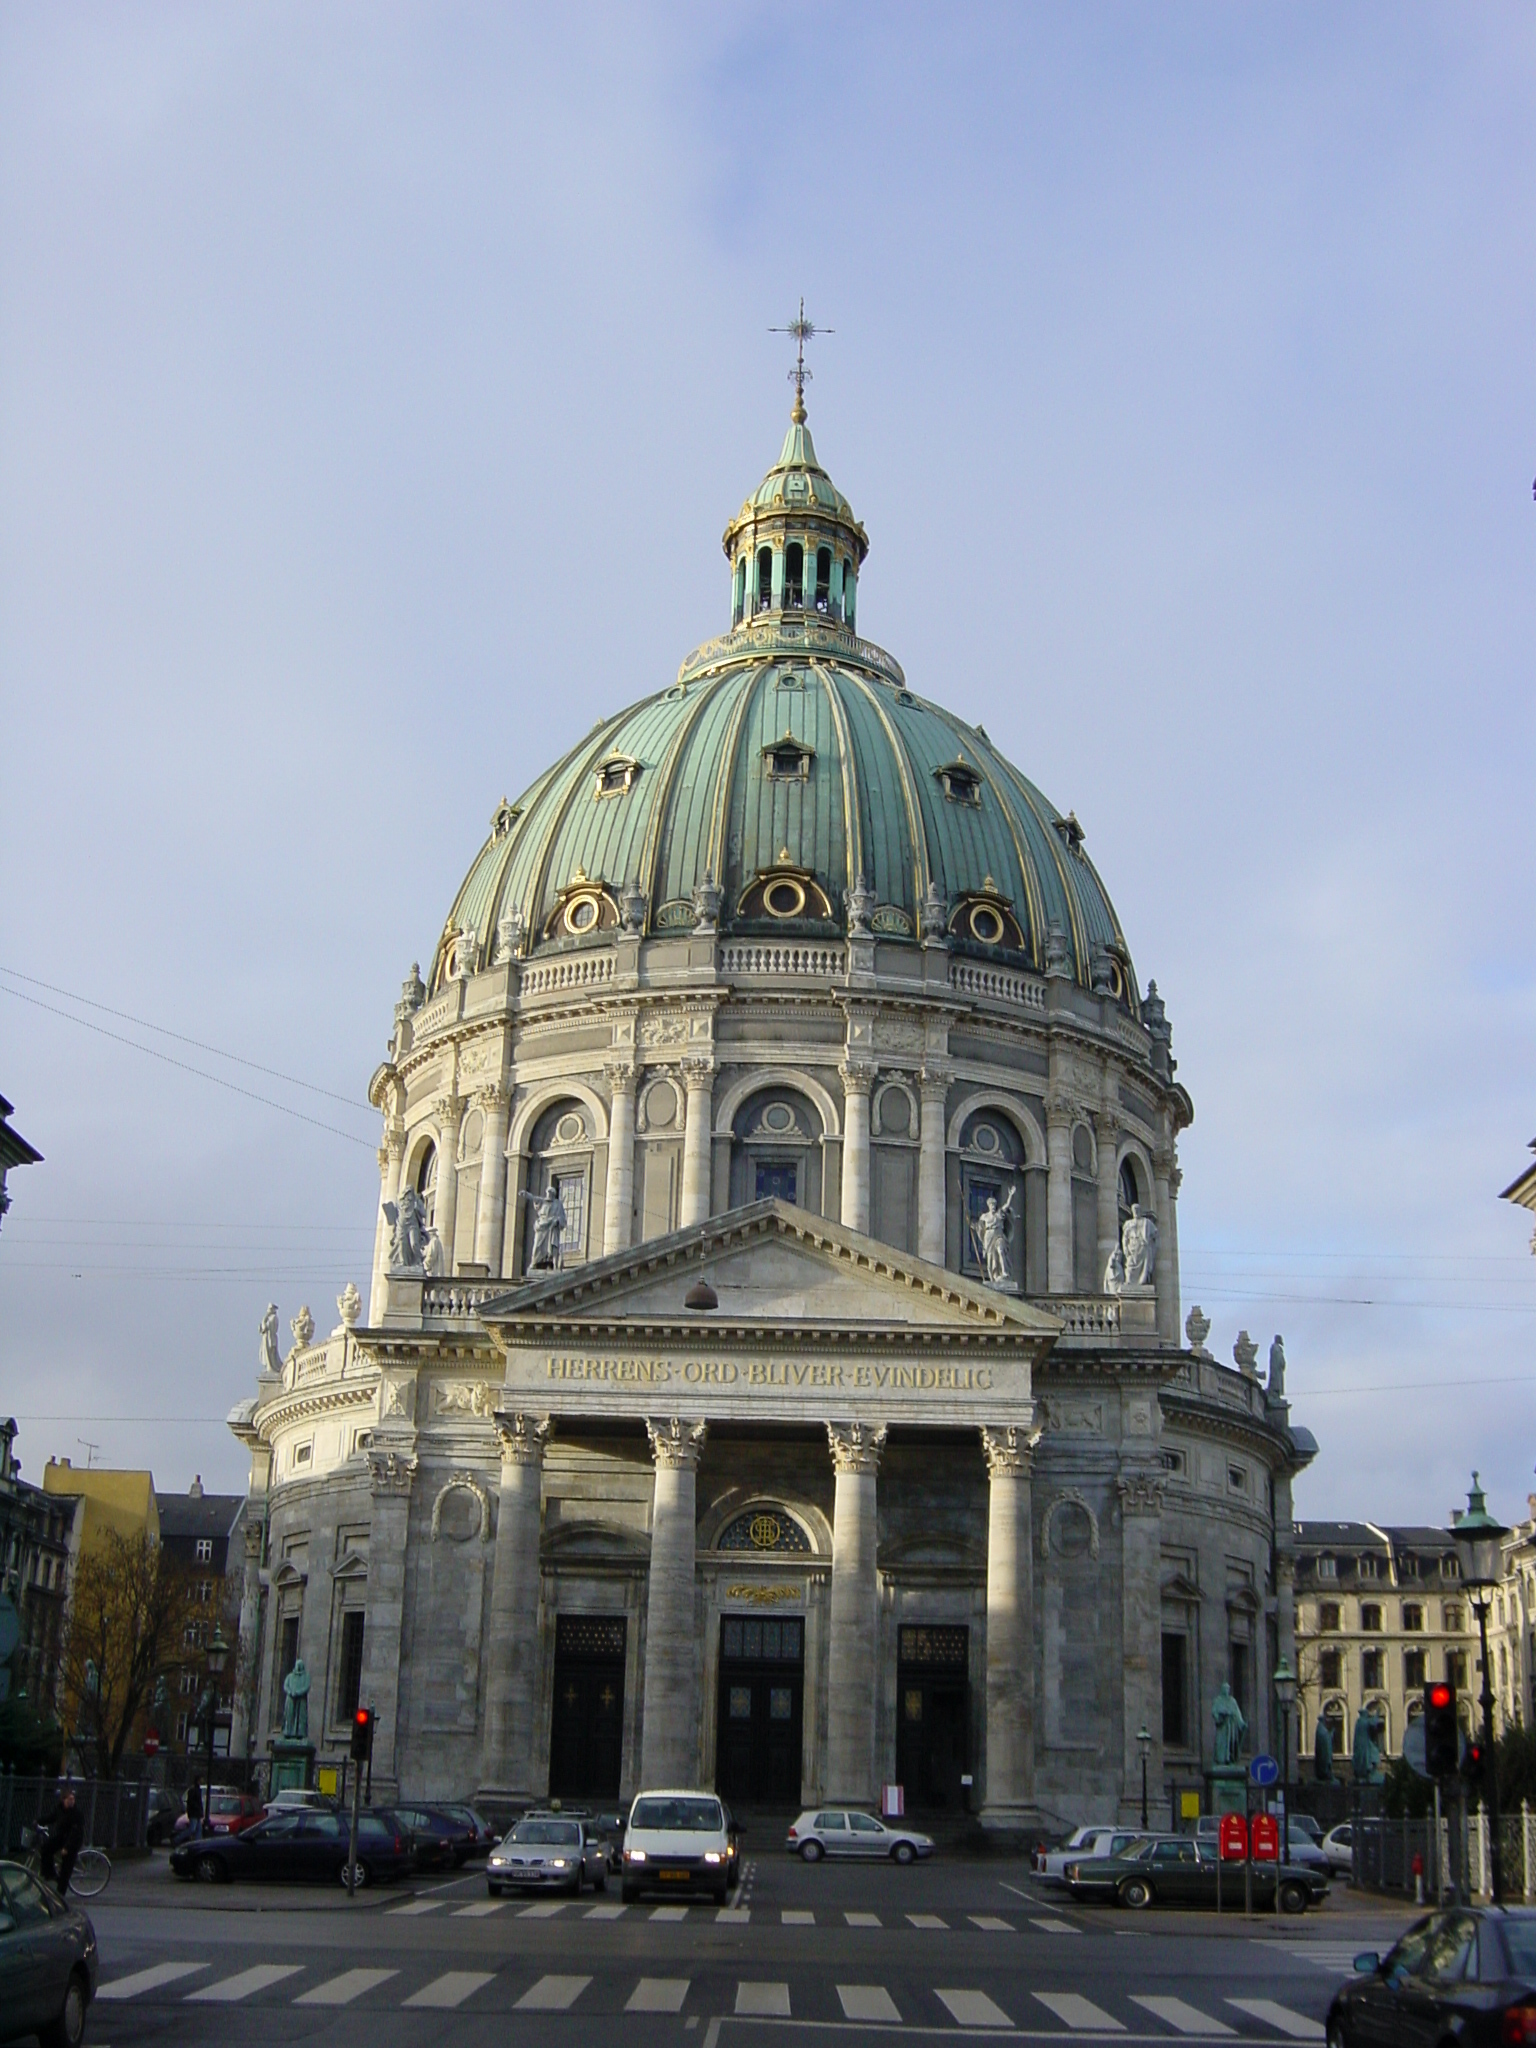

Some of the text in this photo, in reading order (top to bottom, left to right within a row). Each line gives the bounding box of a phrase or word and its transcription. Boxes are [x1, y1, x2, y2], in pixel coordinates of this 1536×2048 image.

[546, 1357, 671, 1382] HERRENS
[681, 1361, 738, 1383] ORD
[748, 1362, 844, 1386] BLIVER
